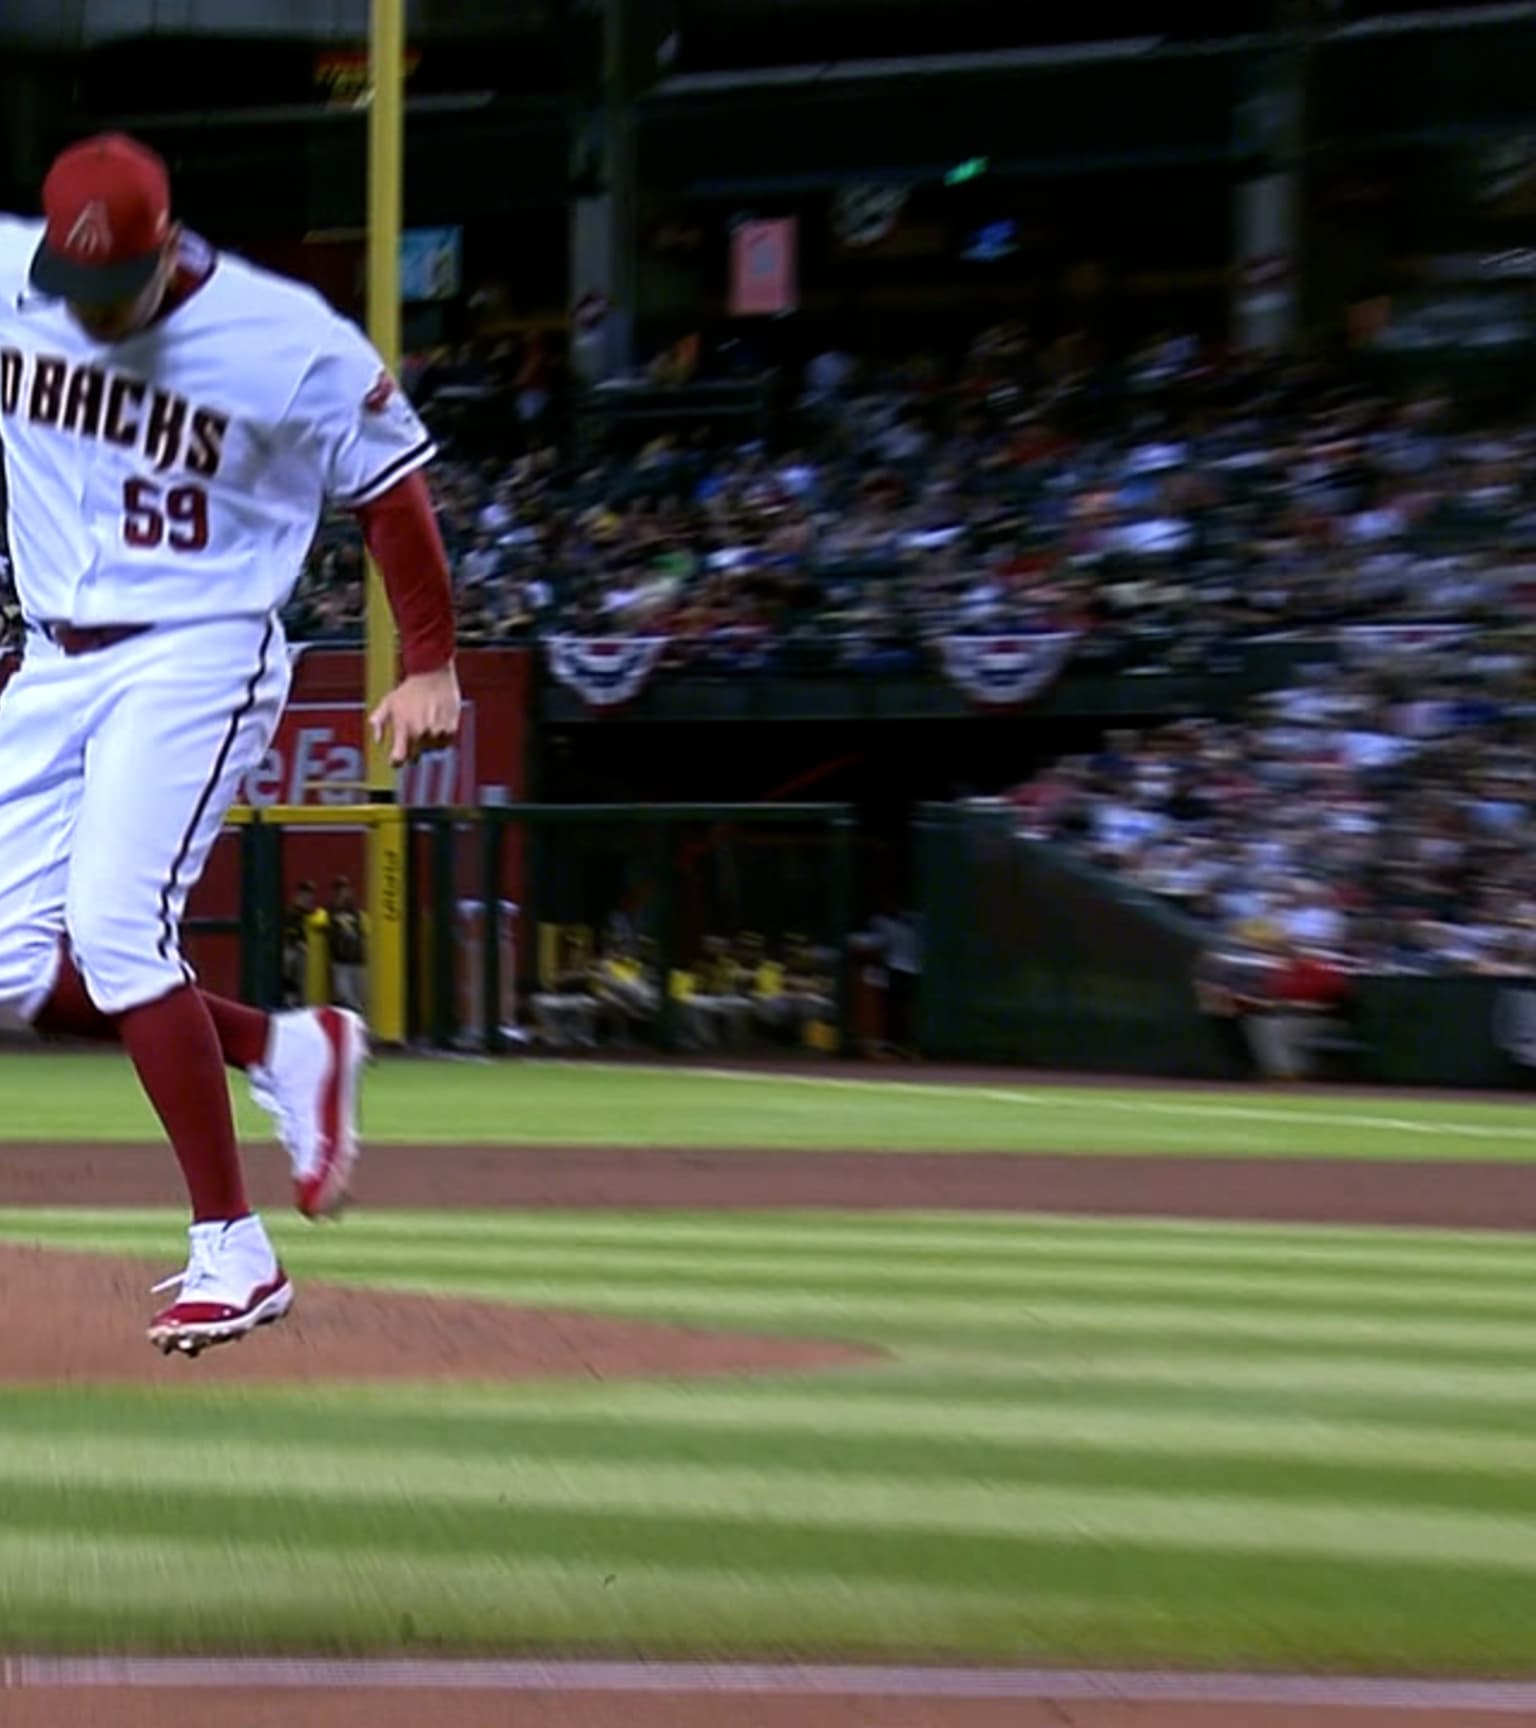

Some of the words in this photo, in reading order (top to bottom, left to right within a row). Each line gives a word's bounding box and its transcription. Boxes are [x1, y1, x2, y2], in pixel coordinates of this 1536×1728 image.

[27, 353, 232, 478] BACKS
[122, 475, 210, 554] 59
[287, 727, 460, 806] Fam
